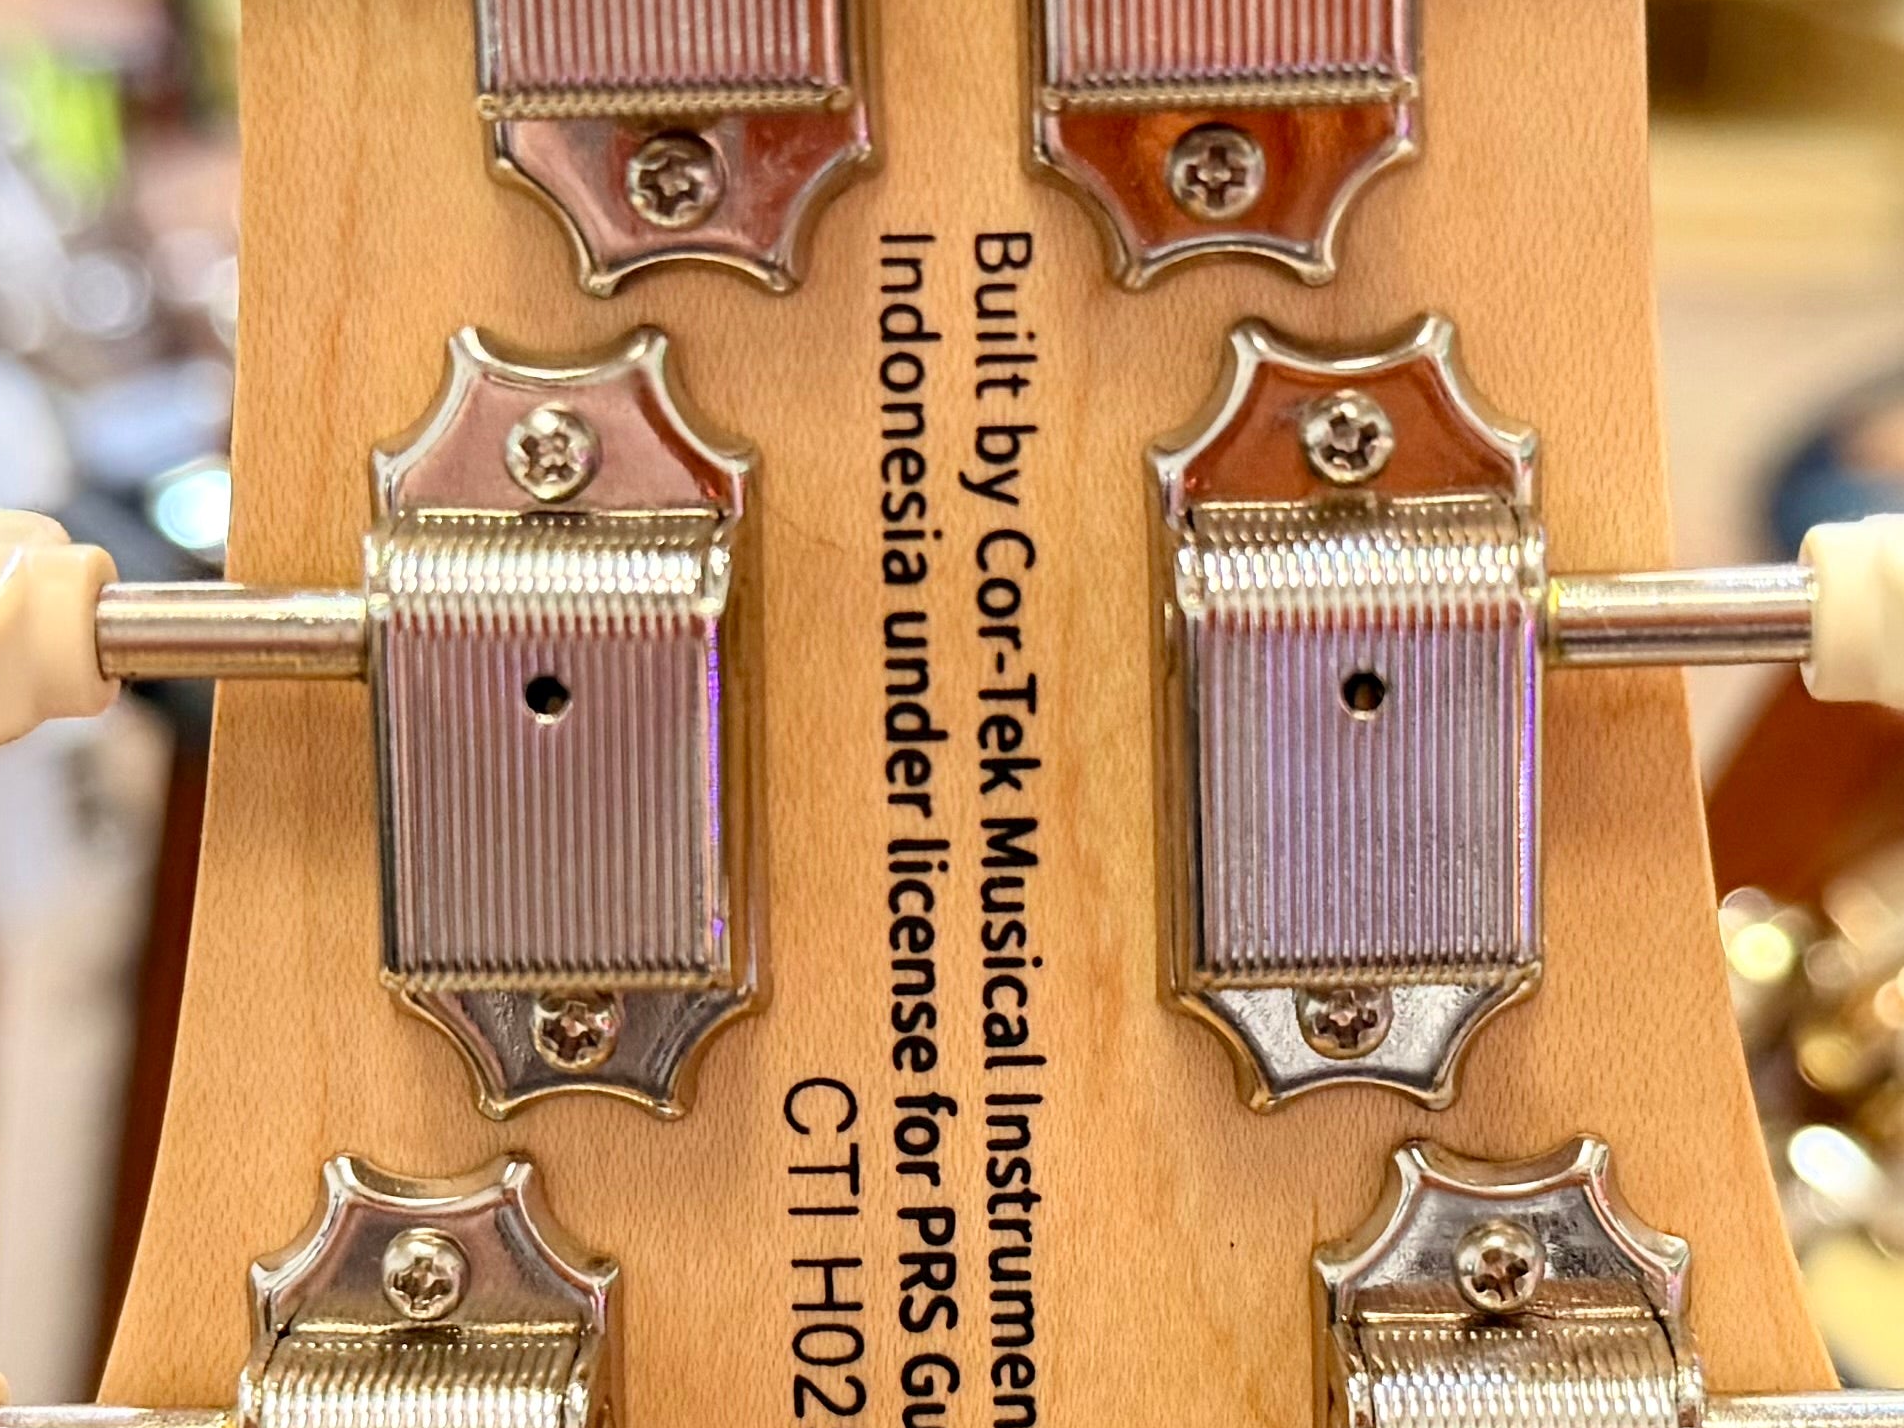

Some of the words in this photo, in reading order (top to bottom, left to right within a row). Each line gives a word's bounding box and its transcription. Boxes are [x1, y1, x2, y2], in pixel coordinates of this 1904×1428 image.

[877, 232, 944, 587] Indonesia
[972, 230, 1039, 401] Built
[957, 423, 1040, 508] by
[882, 609, 951, 820] under
[974, 527, 1043, 797] Cor-Tek
[885, 837, 952, 1075] license
[978, 815, 1049, 1072] Musical
[781, 1076, 861, 1218] CTI
[892, 1090, 959, 1189] for
[895, 1204, 960, 1335] PRS
